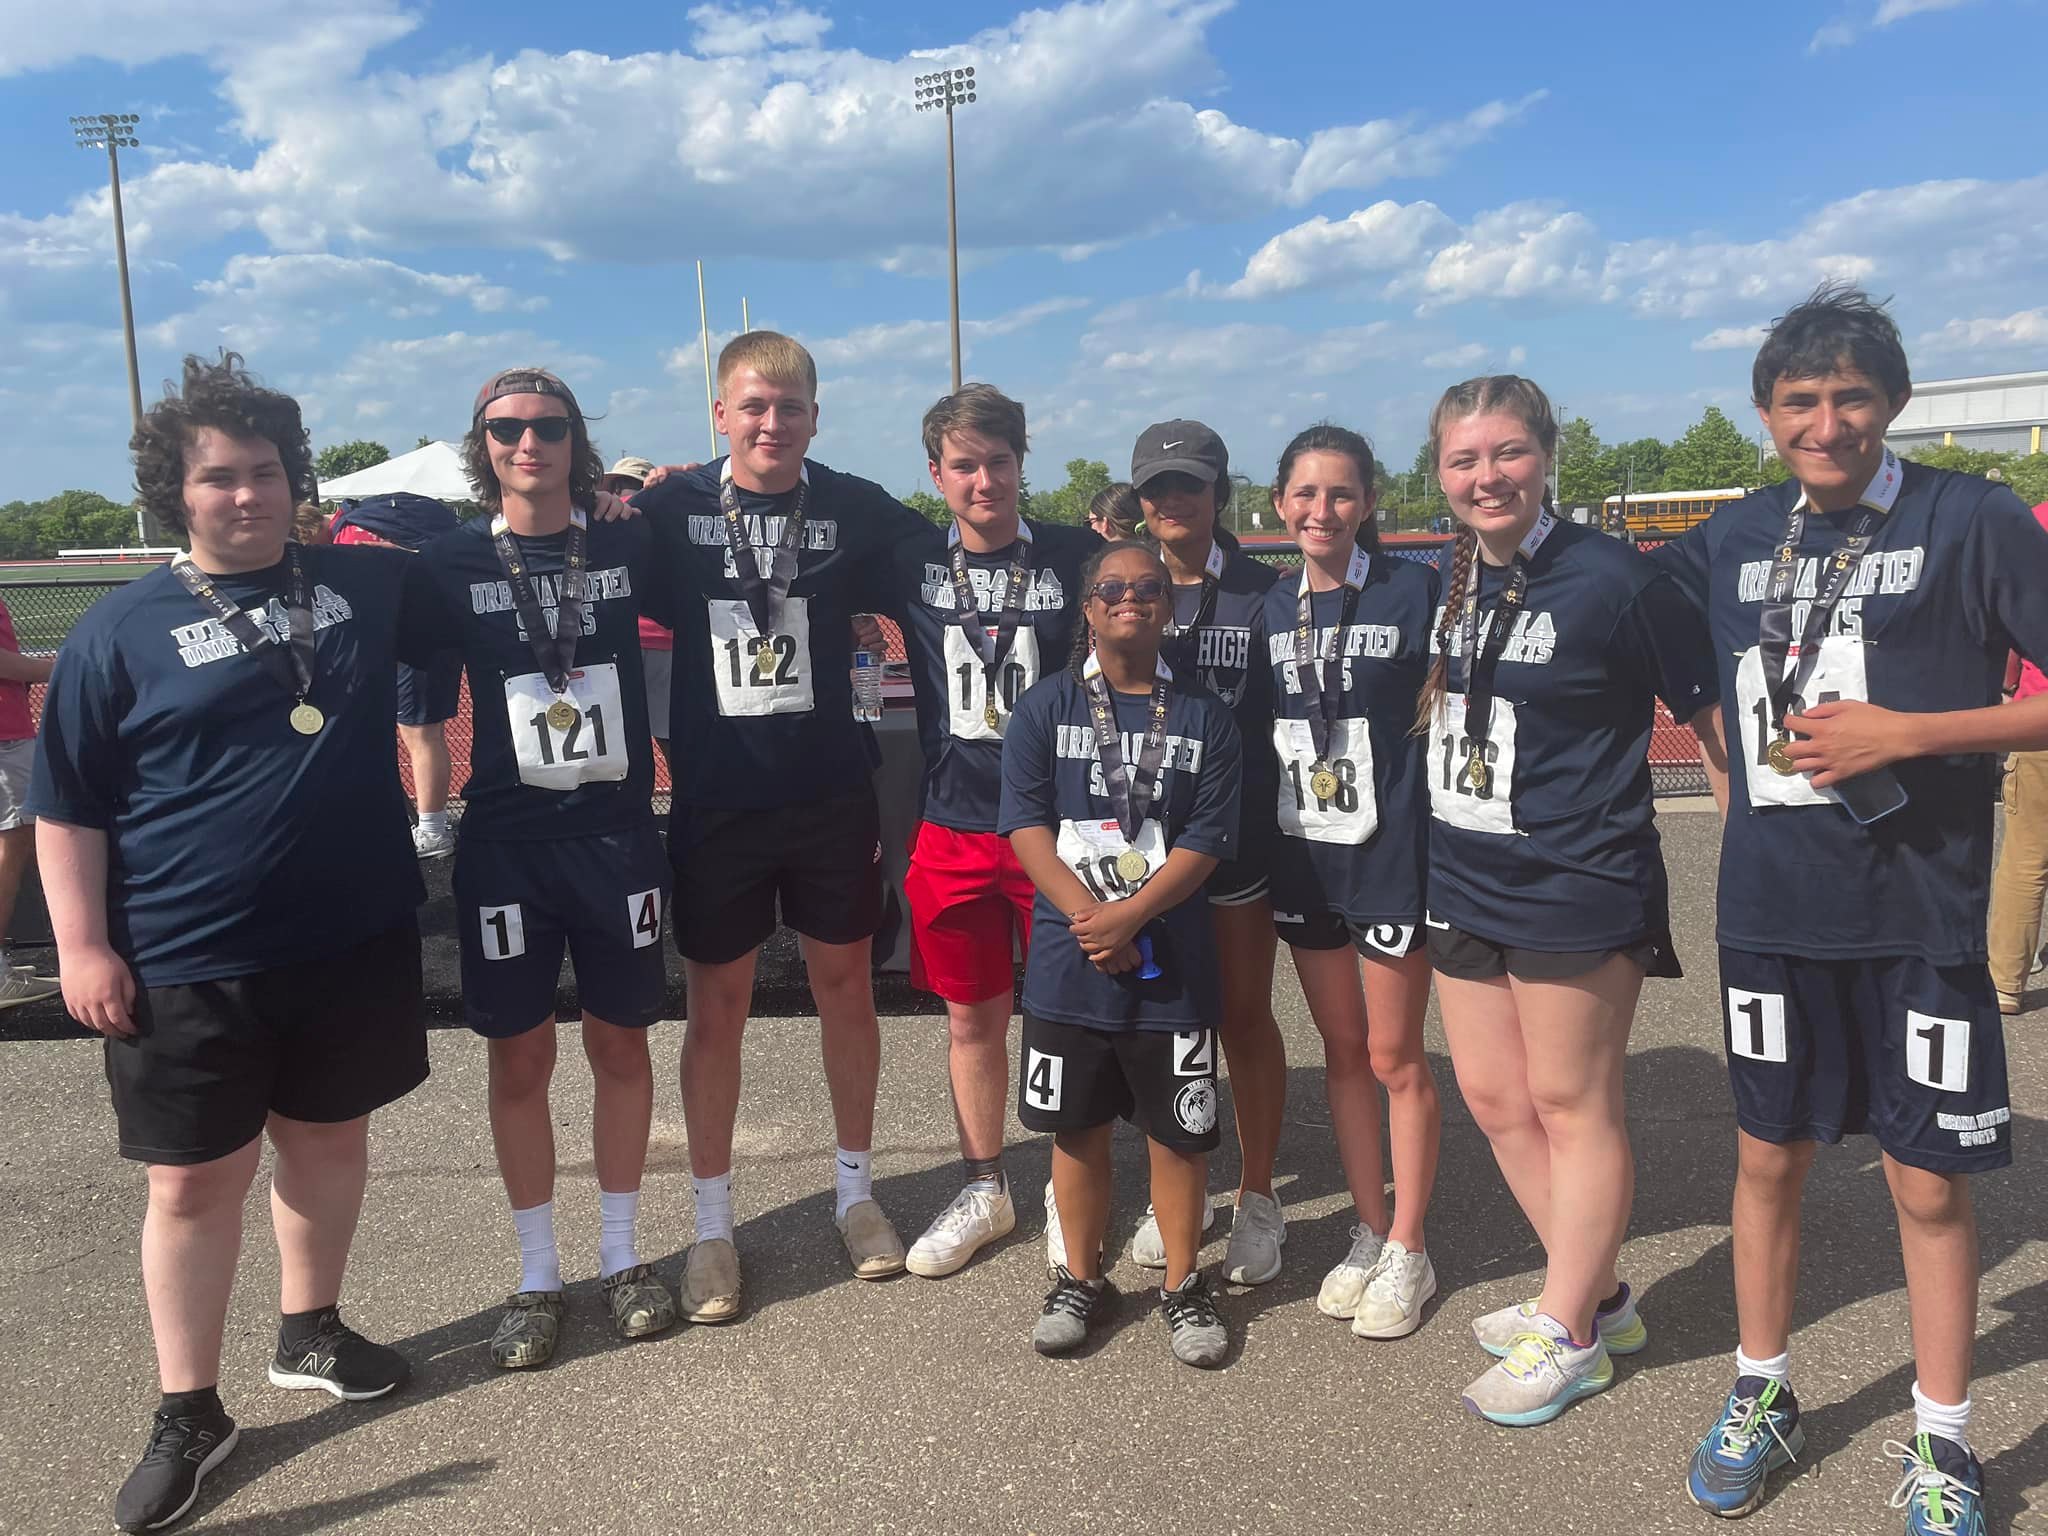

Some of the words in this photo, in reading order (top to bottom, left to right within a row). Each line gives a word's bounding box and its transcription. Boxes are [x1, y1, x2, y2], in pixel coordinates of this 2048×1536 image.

[688, 515, 763, 545] URBA
[1738, 558, 1817, 603] URBA
[1823, 546, 1925, 597] IFIED
[1836, 552, 1849, 570] 50
[212, 596, 233, 617] YEARS
[470, 575, 556, 614] URBNA
[554, 566, 632, 604] IFIED
[991, 589, 1064, 612] SRTS
[1819, 571, 1840, 605] YEARS
[178, 622, 280, 668] UNIFD
[275, 597, 353, 641] SRTS
[1197, 630, 1252, 669] HIGH
[724, 635, 798, 687] 122
[956, 663, 1025, 712] 10
[530, 704, 607, 765] 121
[1096, 707, 1105, 719] 50
[1100, 721, 1110, 745] YEARS
[1075, 856, 1149, 902] 10
[486, 910, 510, 956] 1
[636, 892, 658, 938] 4
[1738, 998, 1764, 1056] 1
[1180, 1029, 1208, 1072] 2
[1917, 1024, 1945, 1084] 1
[1029, 1057, 1054, 1105] 4
